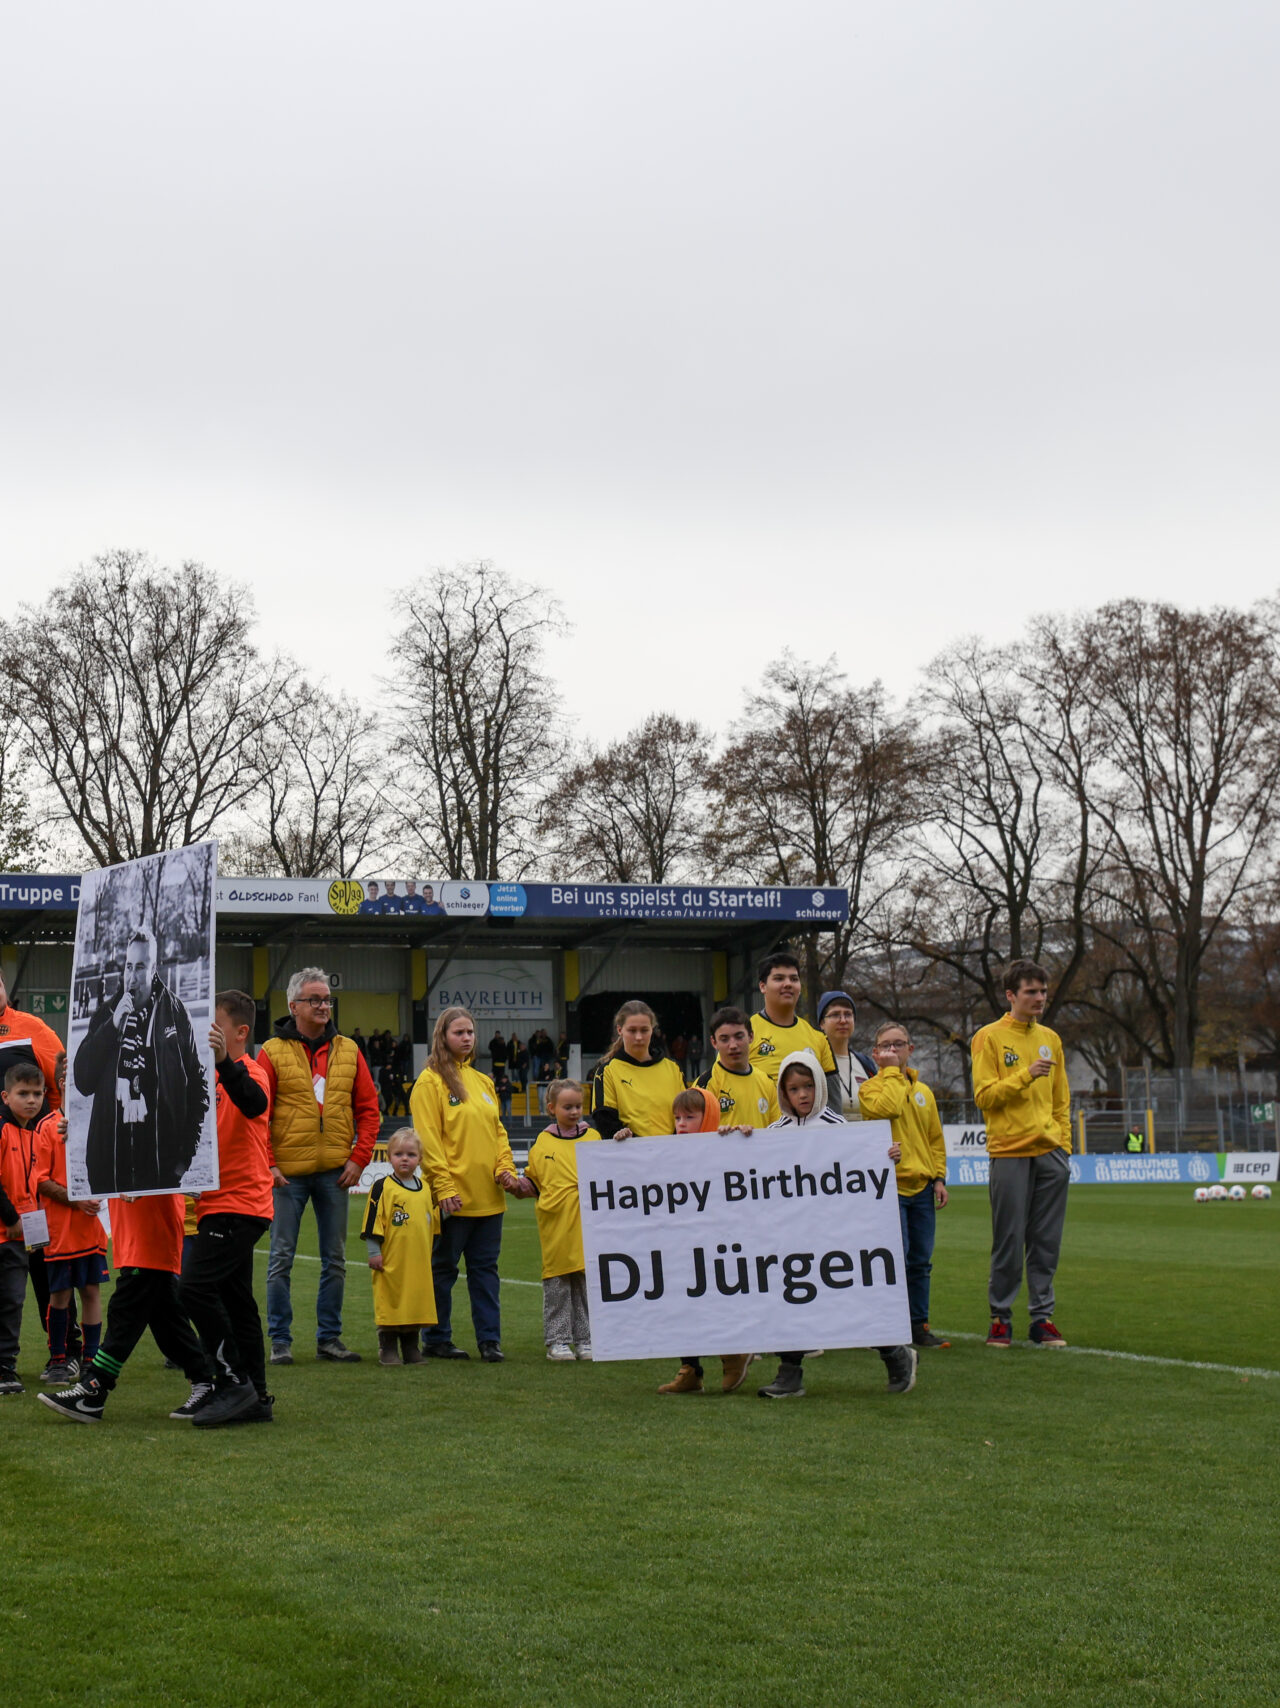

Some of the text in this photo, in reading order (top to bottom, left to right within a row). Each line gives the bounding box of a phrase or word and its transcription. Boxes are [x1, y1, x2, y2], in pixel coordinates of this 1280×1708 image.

[497, 885, 517, 893] Jetzt
[298, 892, 319, 902] Fan!
[551, 887, 782, 908] Bei uns spielst du Startelf!
[446, 901, 485, 910] schlaeger
[490, 904, 524, 912] bewerben
[599, 908, 737, 919] schlaeger.com/karriere
[795, 908, 842, 919] schlaeger
[439, 990, 542, 1009] BAYREUTH
[1109, 1158, 1178, 1169] BAYREUTHER
[1245, 1162, 1270, 1176] cep
[589, 1161, 890, 1215] Happy Birthday
[598, 1243, 897, 1305] DJ Jürgen
